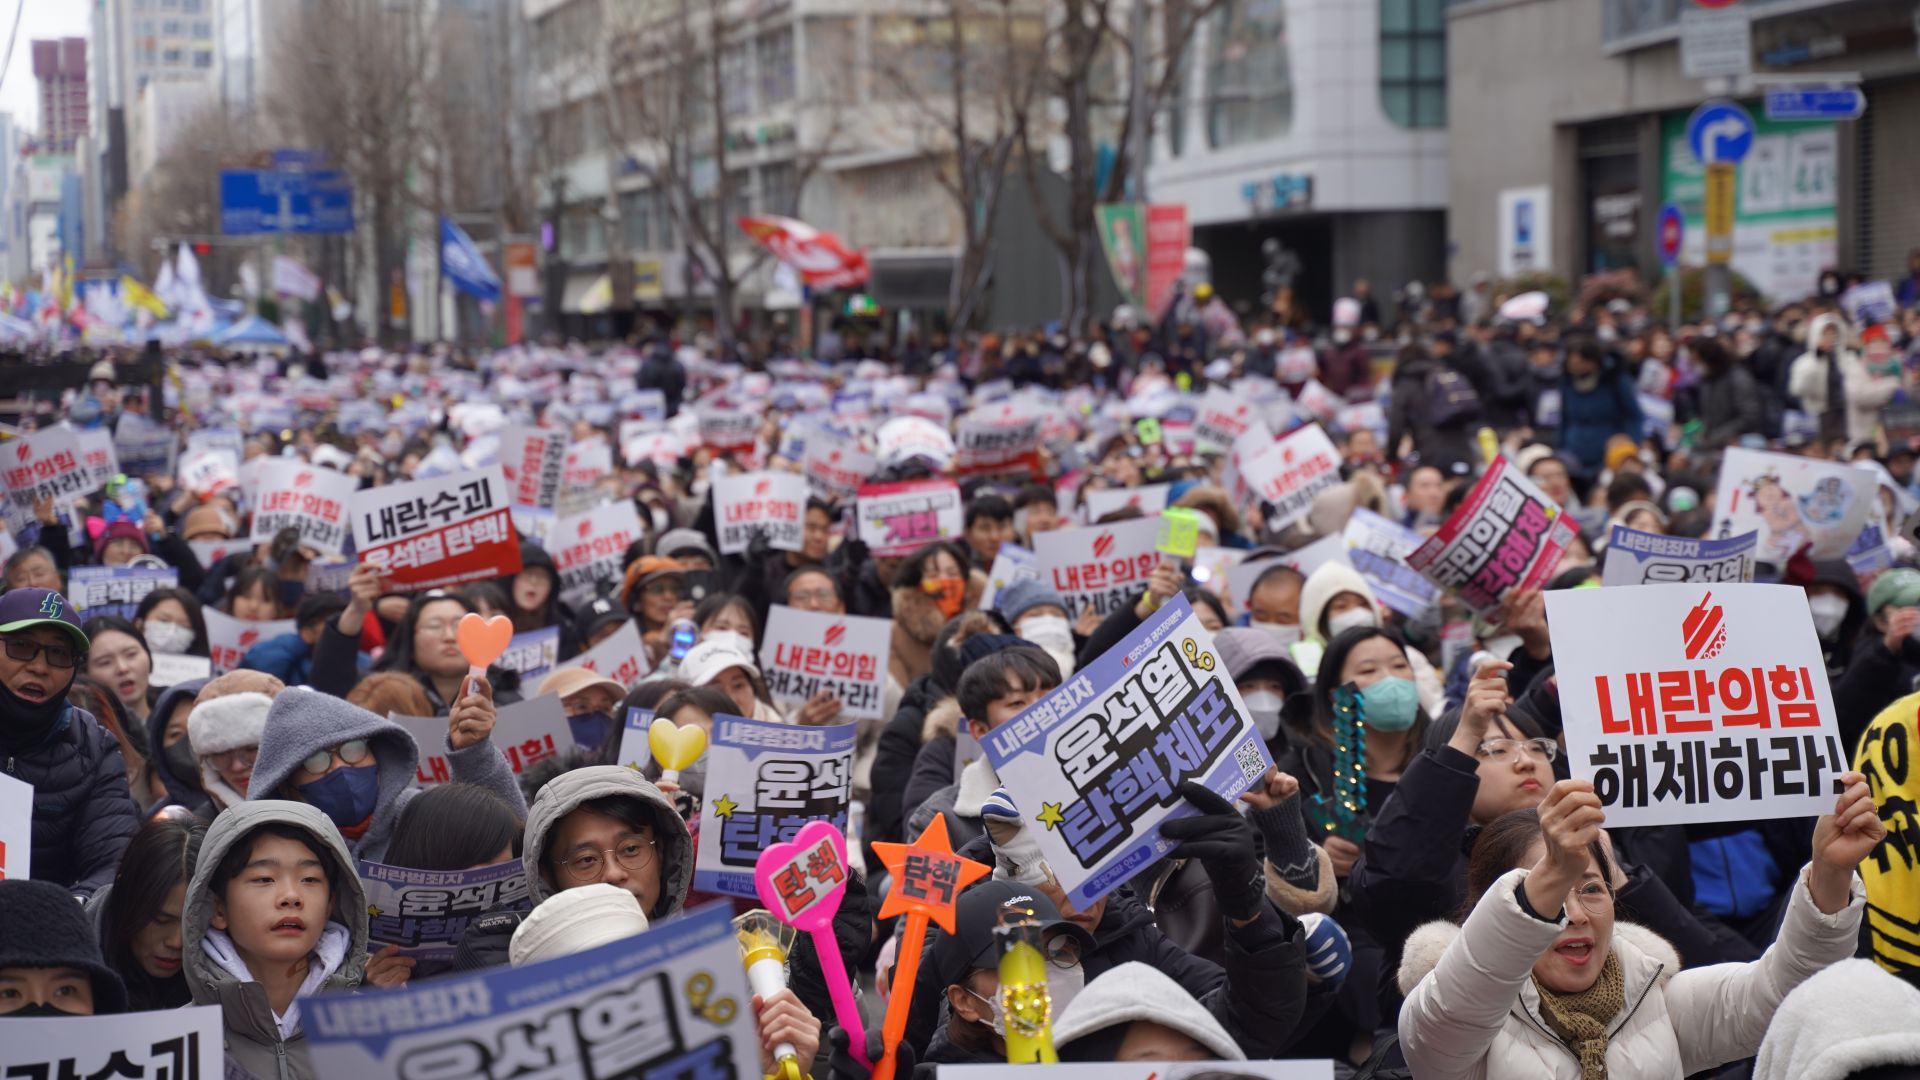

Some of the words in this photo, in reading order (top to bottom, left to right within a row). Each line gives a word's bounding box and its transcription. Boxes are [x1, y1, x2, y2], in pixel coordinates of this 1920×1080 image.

[365, 477, 493, 542] 내란수괴
[1431, 477, 1526, 587] 국민의힘
[374, 530, 446, 577] 윤석열
[445, 511, 509, 556] 탄핵!
[1052, 551, 1161, 592] 내란의힘
[1616, 530, 1700, 558] 내란범죄자
[763, 668, 878, 710] 해제하라!
[774, 640, 877, 681] 내란의힘
[992, 675, 1095, 758] 내란범죄자
[1057, 643, 1195, 790] 윤석열
[1594, 664, 1822, 736] 내란의힘
[719, 720, 826, 750] 내란범죄자
[1060, 678, 1238, 862] 탄핵체포
[1589, 735, 1846, 809] 해제하라!
[367, 865, 465, 886] 내란범죄자
[774, 840, 845, 915] 탄핵
[903, 855, 961, 904] 탄핵
[1004, 895, 1033, 908] adidas
[313, 978, 493, 1038] 내란범죄자
